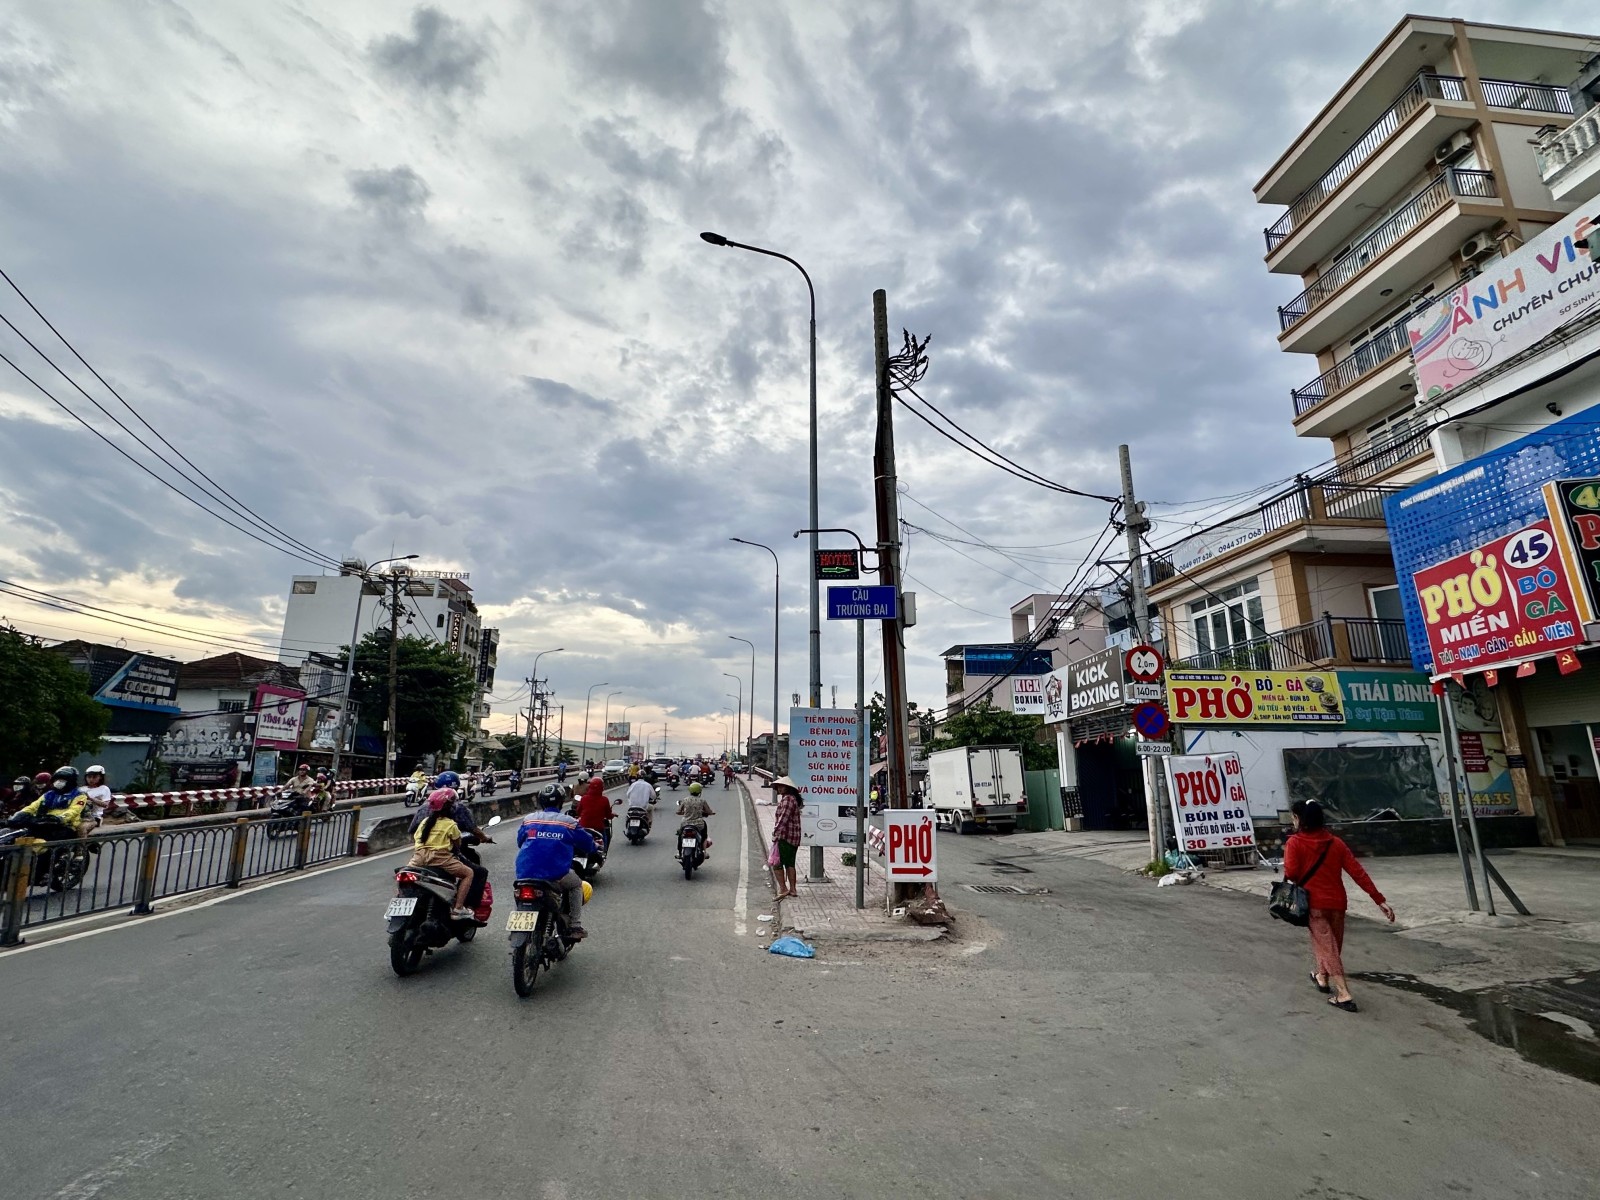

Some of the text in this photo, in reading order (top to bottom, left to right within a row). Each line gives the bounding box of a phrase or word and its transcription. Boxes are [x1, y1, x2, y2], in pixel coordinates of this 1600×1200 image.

[1451, 267, 1527, 334] ẢNH
[1559, 291, 1596, 316] SƠ SINH
[1493, 290, 1553, 332] CHUYÊN
[1511, 533, 1549, 564] 45
[820, 554, 855, 567] HOTEL
[1420, 550, 1503, 624] PHỞ
[1517, 566, 1557, 595] BÒ
[852, 587, 869, 601] CẦU
[836, 602, 871, 616] TRƯỜNG
[1525, 592, 1567, 619] GÀ
[1440, 609, 1510, 645] MIẾN
[1459, 644, 1481, 662] NẠM
[1543, 620, 1575, 641] VIÊN
[1076, 660, 1109, 687] KICK
[1015, 679, 1041, 692] KICK
[1255, 676, 1303, 691] BÒ GÀ
[1348, 679, 1390, 702] THÁI
[1393, 680, 1436, 703] BÌNH
[1015, 695, 1043, 704] BOXING
[1071, 680, 1120, 709] BOXING
[1136, 687, 1159, 697] 140m
[1172, 675, 1253, 718] PHỞ
[804, 715, 856, 724] TIÊM PHÒNG
[810, 726, 833, 736] BỆNH
[808, 749, 852, 760] LÀ BẢO VỆ
[808, 761, 851, 771] SỨC KHỎE
[1225, 755, 1240, 775] BÒ
[827, 773, 848, 782] ĐÌNH
[1175, 756, 1221, 807] PHỞ
[812, 784, 835, 795] CỘNG
[1230, 782, 1245, 802] GÀ
[1185, 807, 1245, 822] BÚN BÒ
[1184, 820, 1251, 836] HỦ TIẾU BÒ VIÊN GÀ
[889, 816, 933, 864] PHỞ
[1186, 835, 1253, 849] 30 35K
[513, 911, 535, 921] 37-E1
[508, 921, 535, 930] 744.09
